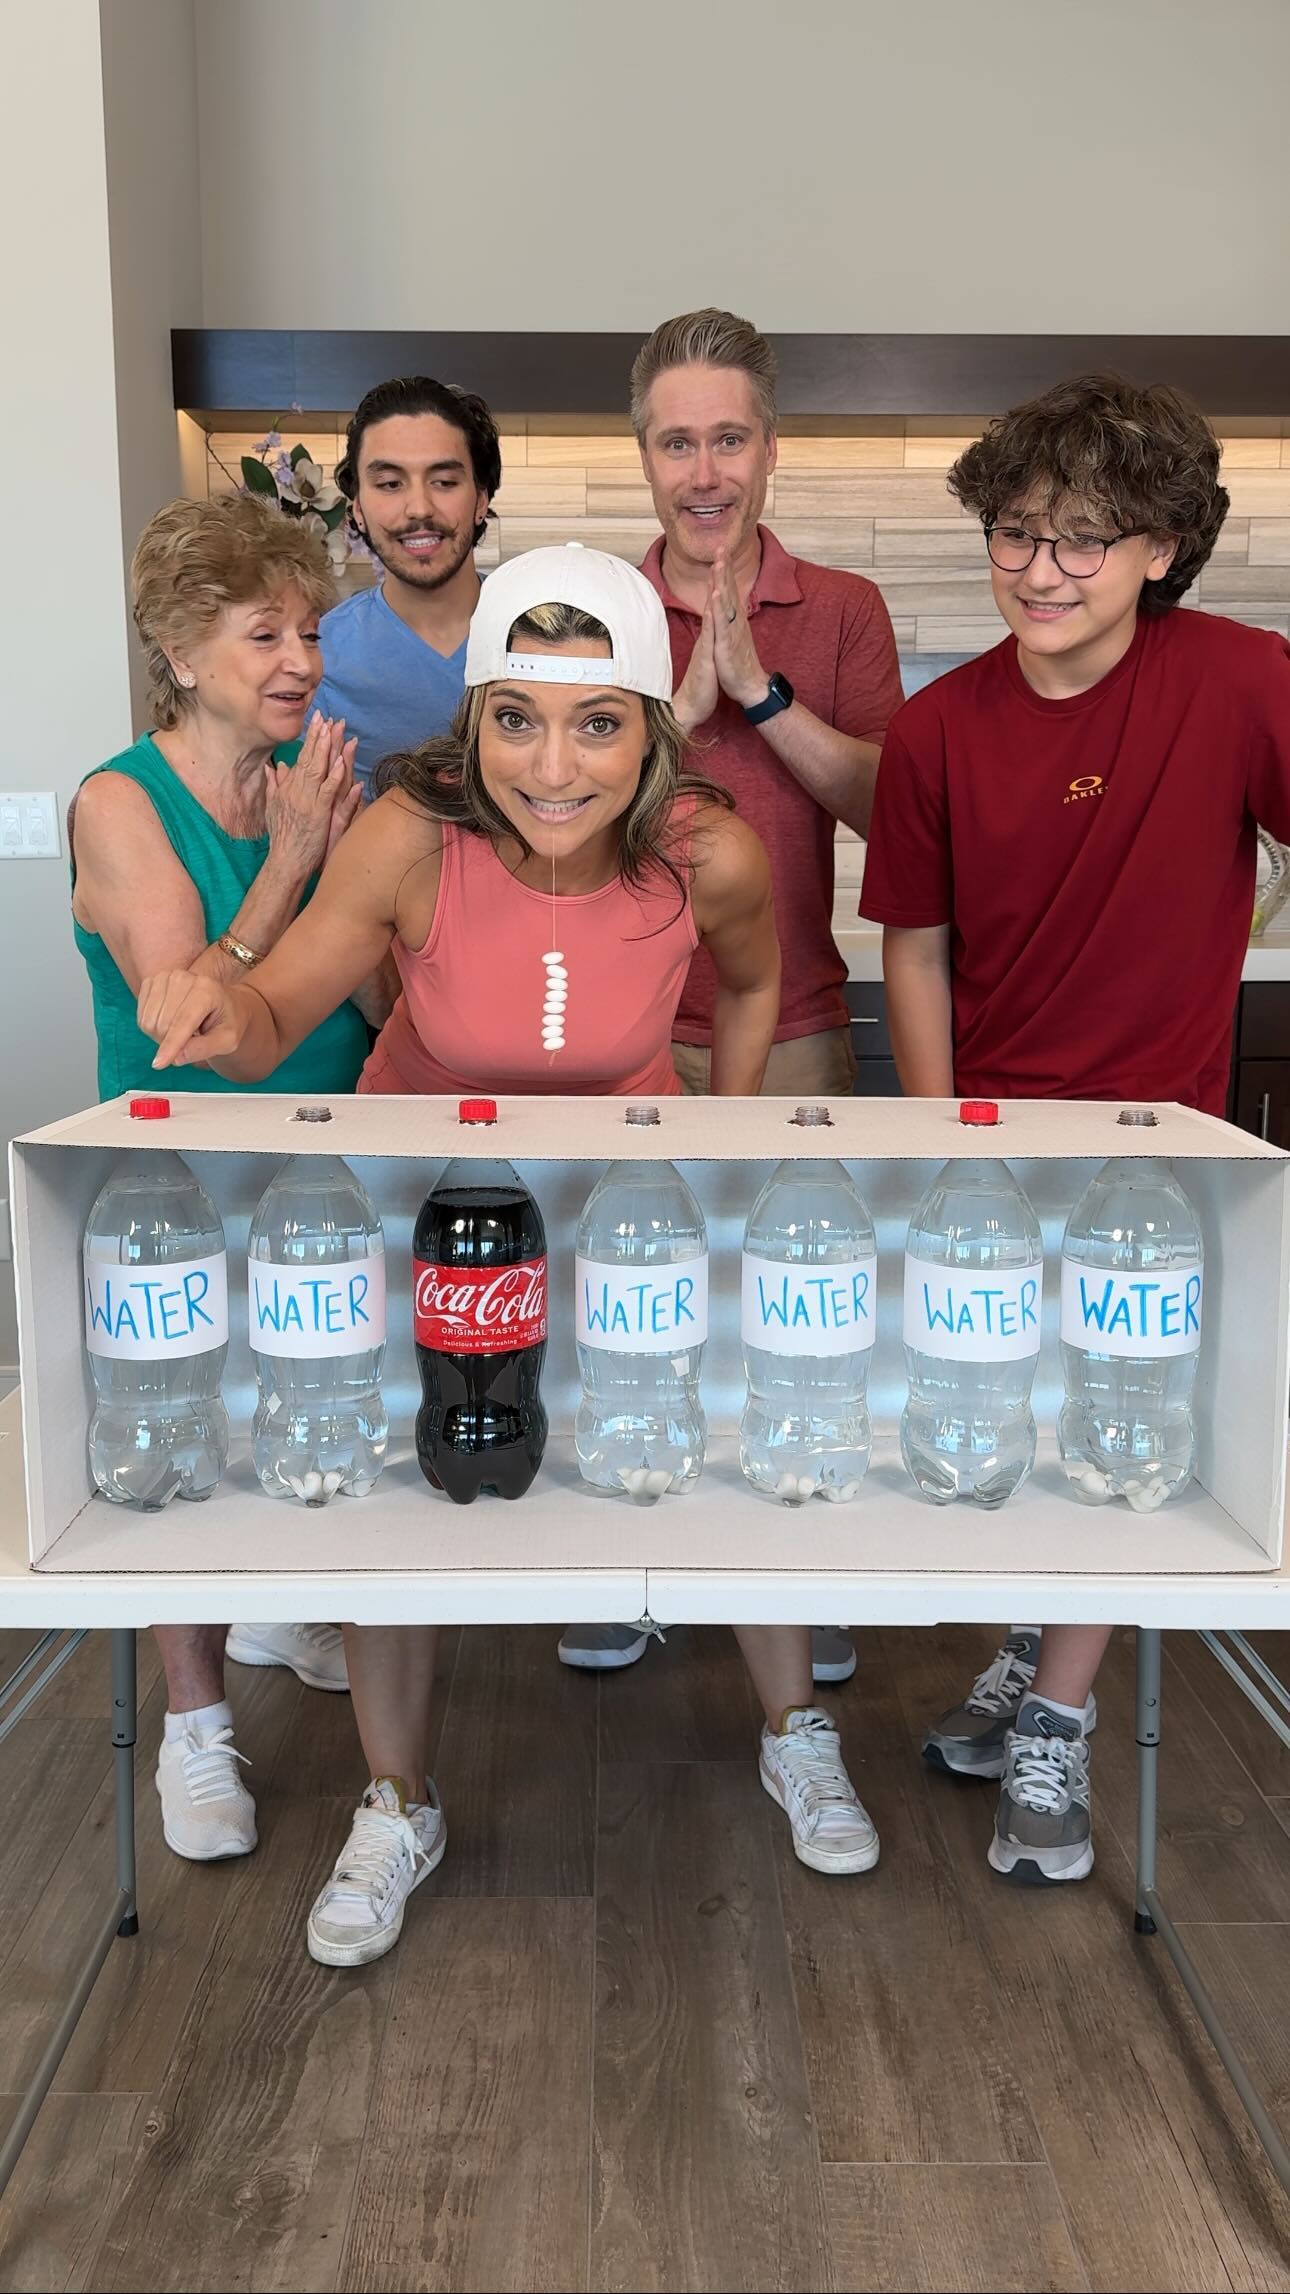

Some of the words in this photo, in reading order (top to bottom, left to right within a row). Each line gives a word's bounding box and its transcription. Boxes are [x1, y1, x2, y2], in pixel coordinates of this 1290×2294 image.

[1063, 786, 1108, 804] OAKLE
[87, 1271, 214, 1340] WATER
[254, 1274, 370, 1335] WATER
[416, 1261, 546, 1328] Coca-Cola
[584, 1278, 695, 1335] WATER
[759, 1271, 869, 1329] WATER
[923, 1279, 1037, 1337] WATER
[1079, 1275, 1201, 1338] WATER
[441, 1327, 487, 1336] ORIGINAL
[490, 1325, 519, 1335] TASTE
